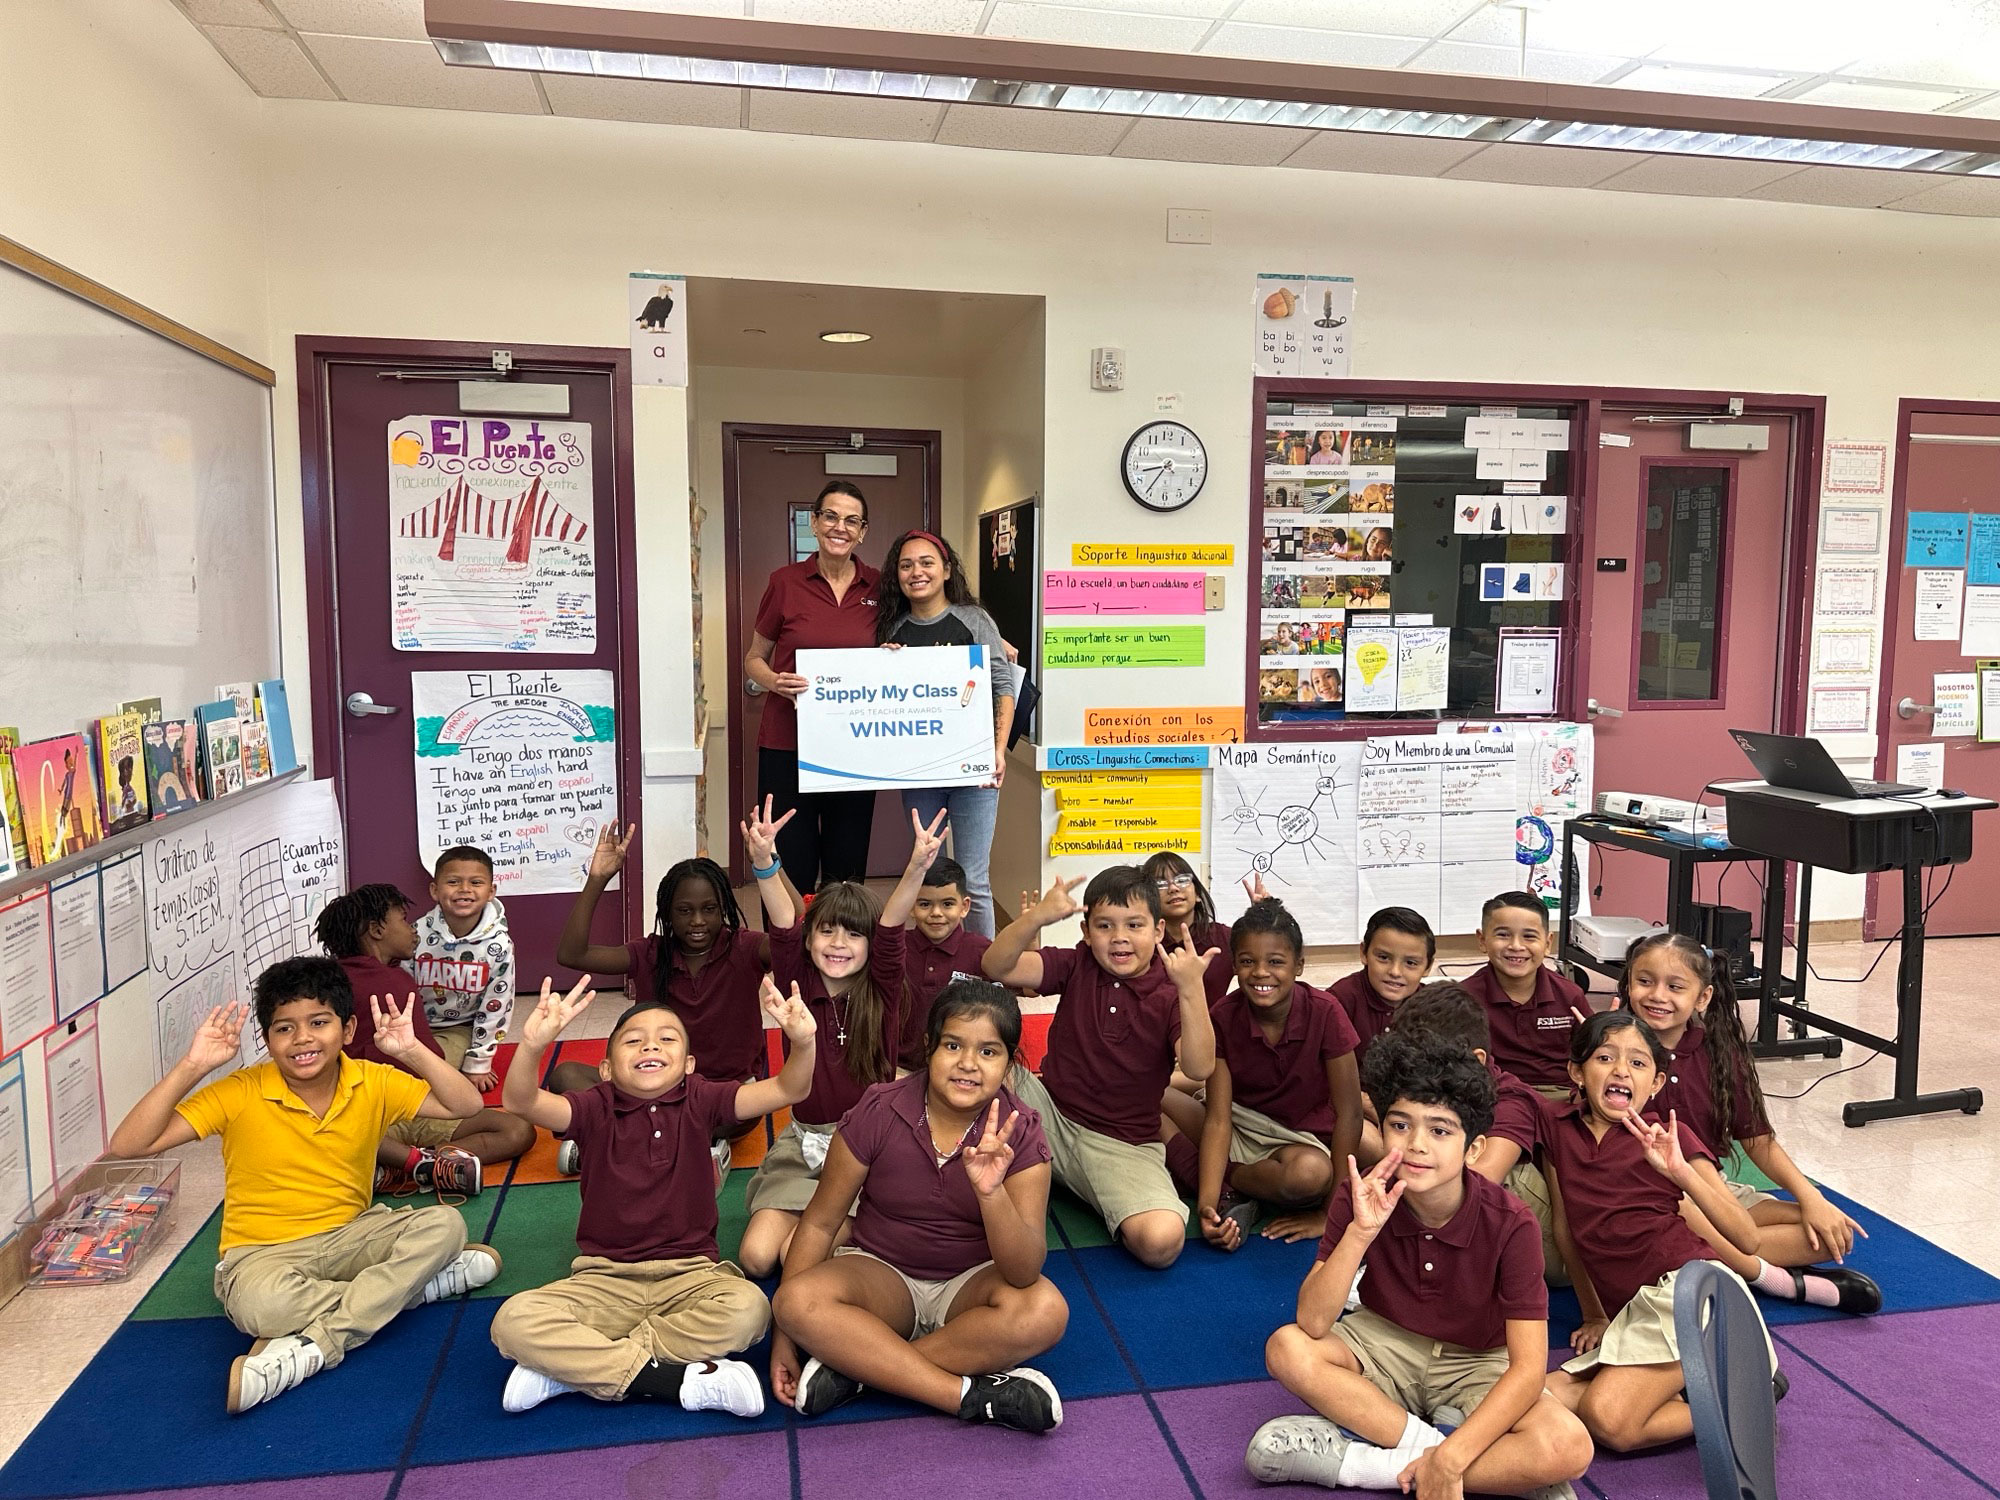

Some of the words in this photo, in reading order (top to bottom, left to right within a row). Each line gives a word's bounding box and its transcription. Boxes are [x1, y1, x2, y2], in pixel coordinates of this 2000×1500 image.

[1264, 331, 1275, 340] ba
[1286, 331, 1294, 340] bi
[1335, 334, 1342, 342] vi
[654, 347, 665, 357] a
[1264, 343, 1275, 351] be
[1284, 344, 1296, 352] bo
[1333, 346, 1343, 354] vo
[1274, 355, 1284, 364] bu
[430, 420, 468, 457] El
[483, 421, 556, 460] Puente
[1148, 435, 1158, 444] 11
[1162, 431, 1173, 441] 12
[1139, 447, 1149, 456] 10
[1132, 461, 1138, 471] 9
[1193, 463, 1199, 472] 3
[394, 473, 448, 489] haciendo
[470, 474, 527, 488] conexiones
[547, 476, 579, 491] entre
[1162, 492, 1168, 501] 6
[1176, 489, 1182, 498] 5
[1079, 545, 1128, 564] Soporte
[1192, 549, 1227, 560] adicional
[1046, 575, 1063, 588] En
[1066, 575, 1077, 588] la
[1130, 577, 1149, 588] buen
[1152, 579, 1189, 588] ciudadano
[1193, 580, 1203, 589] es
[1044, 632, 1058, 645] Es
[1063, 633, 1111, 646] importante
[1114, 634, 1129, 644] ser
[1134, 635, 1144, 643] un
[1149, 632, 1171, 643] buen
[1047, 652, 1095, 664] ciudadano
[1102, 654, 1132, 665] porque
[468, 674, 493, 697] El
[507, 672, 562, 696] Puente
[825, 675, 841, 684] aps
[815, 686, 877, 703] Supply
[882, 686, 908, 701] My
[913, 684, 958, 698] Class
[514, 699, 548, 707] BRIDGE
[1088, 713, 1151, 727] Conexión
[1162, 716, 1182, 725] con
[1195, 713, 1213, 725] los
[456, 718, 479, 743] SPANISH
[850, 720, 944, 737] WINNER
[1094, 730, 1150, 744] estudios
[460, 746, 512, 769] Tengo
[519, 744, 543, 760] dos
[549, 745, 593, 759] manos
[1219, 746, 1258, 768] Mapa
[1267, 746, 1337, 766] Semántico
[1365, 740, 1390, 762] Soy
[1395, 740, 1440, 757] Miembro
[1443, 742, 1453, 756] de
[1455, 747, 1470, 756] una
[1474, 740, 1514, 754] Comunidad
[430, 767, 447, 784] I
[453, 767, 484, 781] have
[488, 769, 506, 779] an
[510, 765, 553, 784] English
[558, 760, 588, 773] hand
[972, 764, 990, 772] aps
[1046, 774, 1093, 785] comunidad
[1107, 774, 1148, 784] community
[433, 786, 476, 804] Tengo
[482, 785, 501, 794] una
[507, 781, 535, 792] mano
[538, 779, 553, 790] en
[558, 772, 594, 790] español
[438, 802, 457, 815] Las
[461, 800, 490, 818] junto
[494, 796, 518, 810] para
[521, 792, 555, 805] formar
[560, 789, 575, 800] un
[576, 785, 614, 802] puente
[437, 820, 451, 830] I
[455, 817, 472, 832] put
[480, 813, 498, 825] the
[503, 807, 539, 824] bridge
[544, 807, 557, 816] on
[560, 805, 576, 819] my
[580, 799, 603, 812] head
[1114, 818, 1158, 829] responsible
[438, 834, 451, 846] Lo
[481, 830, 493, 842] sé
[498, 829, 512, 838] en
[515, 824, 549, 839] español
[282, 835, 338, 863] ¿Cuantos
[487, 844, 497, 854] in
[500, 839, 535, 854] English
[1134, 839, 1188, 851] responsibility
[154, 838, 198, 884] Gráfico
[203, 829, 217, 864] de
[292, 859, 311, 873] de
[313, 853, 338, 870] cada
[520, 854, 530, 865] in
[535, 849, 571, 868] English
[301, 868, 328, 890] uno?
[415, 961, 484, 992] MARVEL
